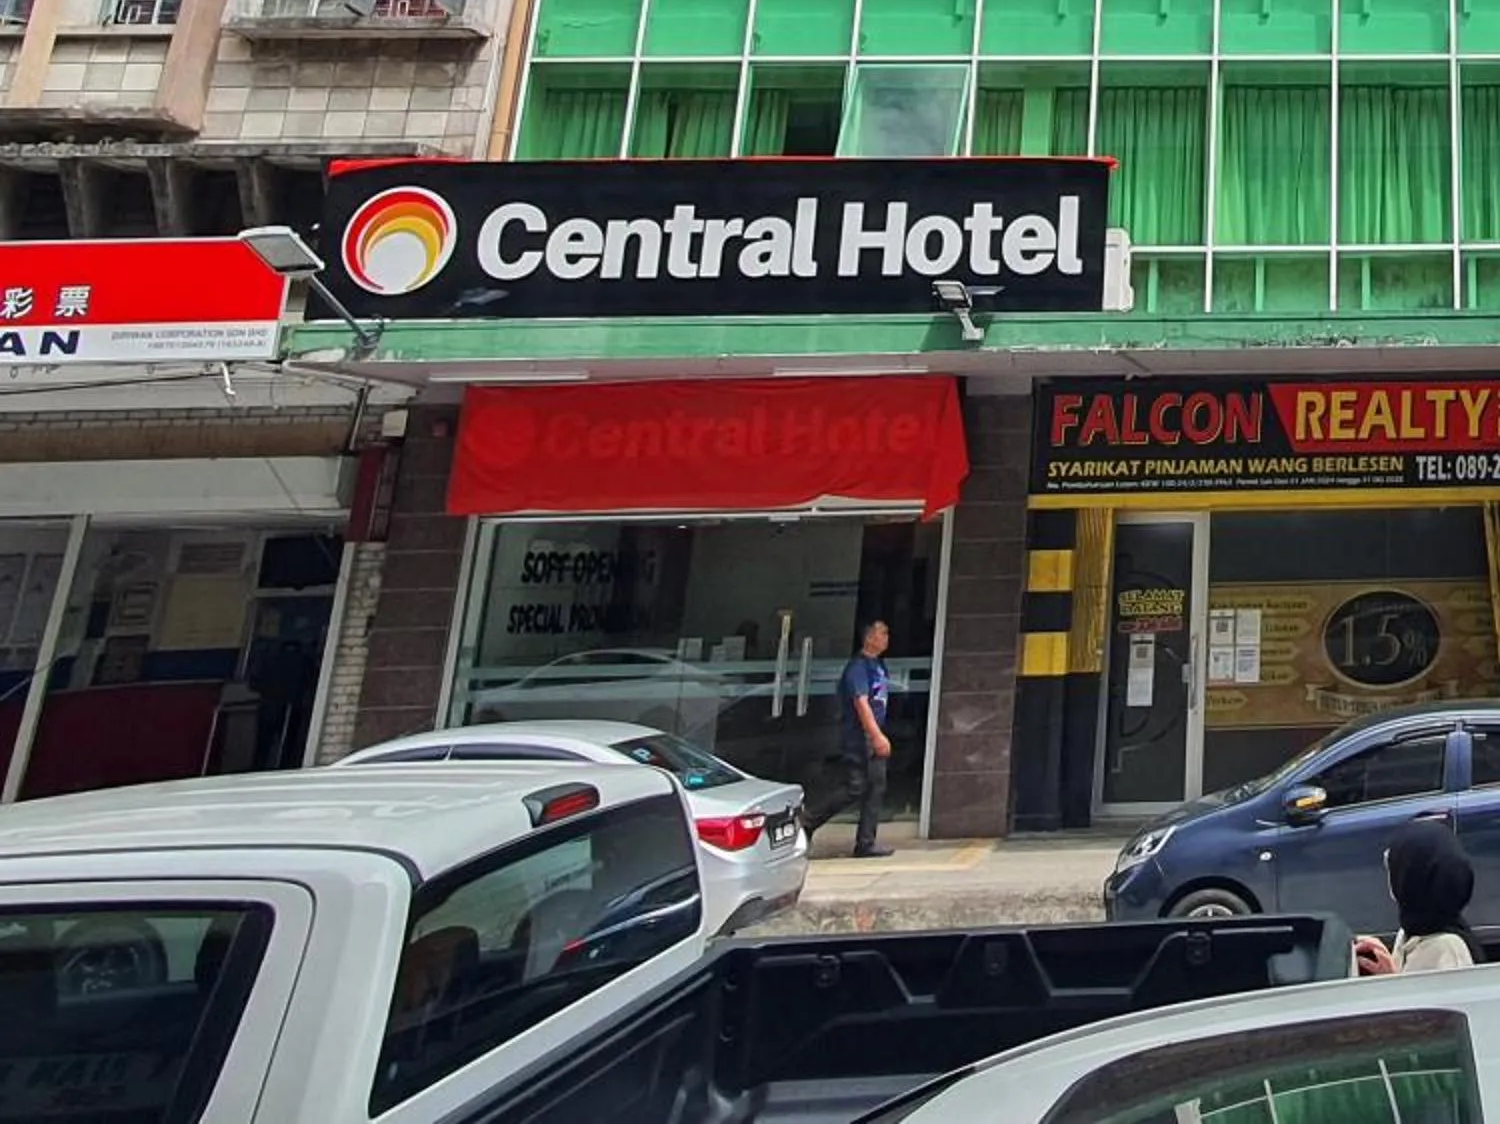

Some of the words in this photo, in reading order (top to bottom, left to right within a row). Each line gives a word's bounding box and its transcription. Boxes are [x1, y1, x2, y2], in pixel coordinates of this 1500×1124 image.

[477, 197, 818, 280] Central
[837, 195, 1083, 276] Hotel
[1050, 392, 1264, 446] FALCON
[1294, 389, 1492, 440] REALTY
[1048, 459, 1142, 477] SYARIKAT
[1145, 458, 1243, 475] PINJAMAN
[1247, 456, 1309, 474] WANG
[1312, 455, 1404, 473] BERLESEN
[1415, 455, 1452, 481] TEL:
